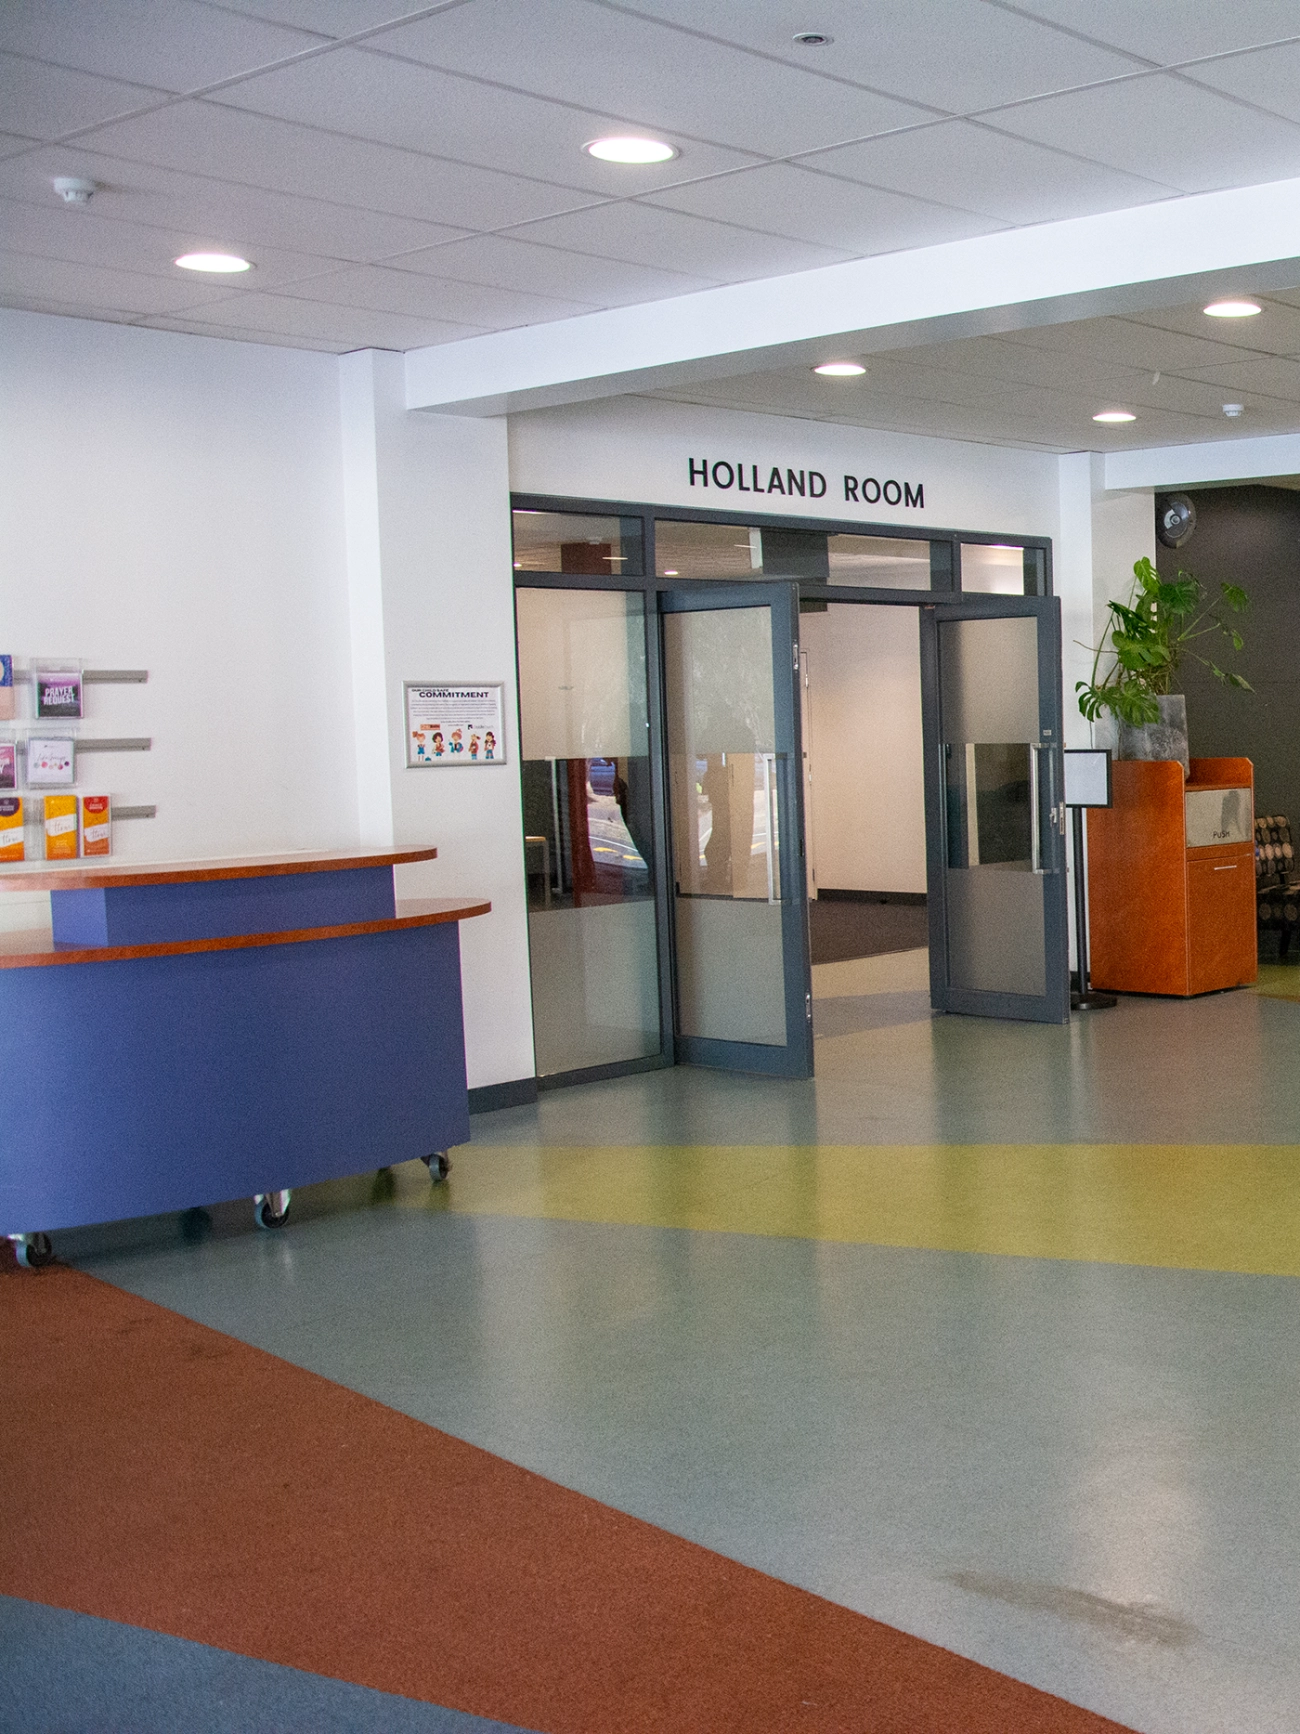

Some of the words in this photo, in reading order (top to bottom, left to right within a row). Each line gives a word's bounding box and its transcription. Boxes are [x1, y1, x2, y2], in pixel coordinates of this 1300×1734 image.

[688, 457, 827, 499] HOLLAND
[843, 475, 925, 509] ROOM
[45, 686, 73, 697] PRAYER
[43, 695, 75, 705] REQUEST
[1212, 830, 1230, 839] PUSH
